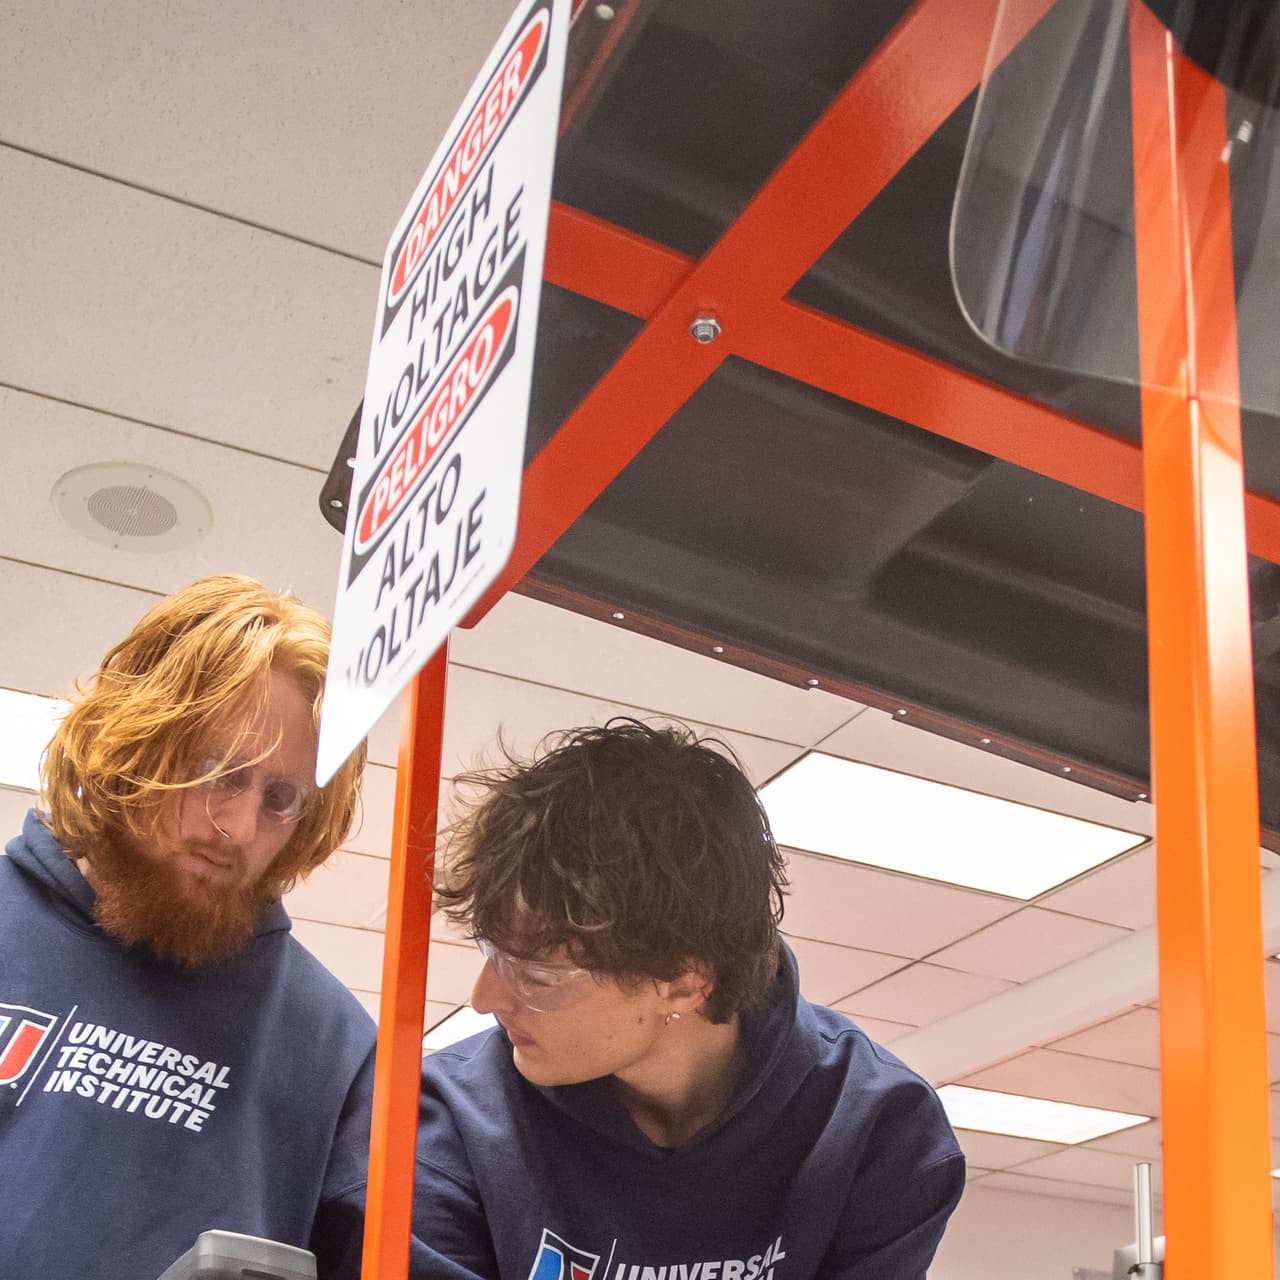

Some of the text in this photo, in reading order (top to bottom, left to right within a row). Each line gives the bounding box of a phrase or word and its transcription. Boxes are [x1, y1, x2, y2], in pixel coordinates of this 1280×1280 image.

[404, 50, 523, 281] DANGER
[408, 161, 495, 343] HIGH
[372, 184, 524, 459] VOLTAGE
[371, 324, 495, 533] PELIGRO
[346, 487, 488, 688] VOLTAJE
[375, 452, 462, 611] ALTO
[43, 1070, 210, 1132] INSTITUTE
[57, 1046, 218, 1111] TECHNICAL
[68, 1022, 231, 1089] UNIVERSAL
